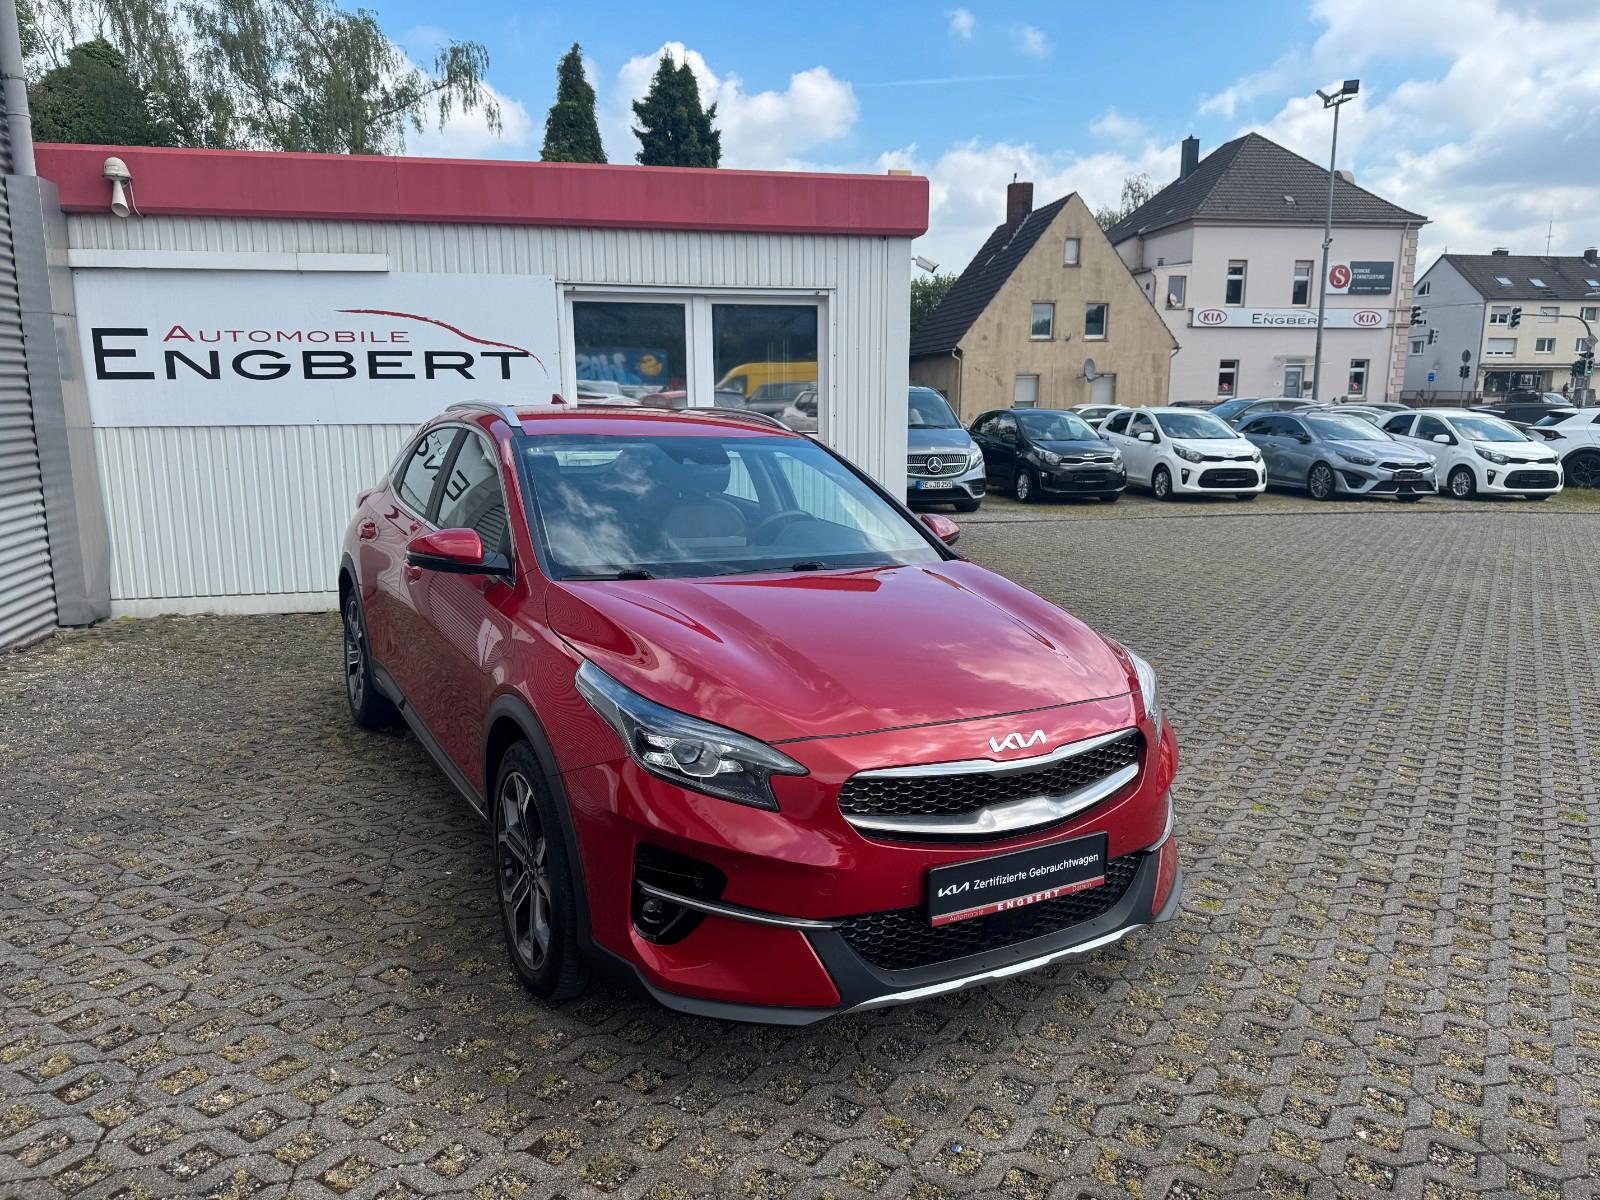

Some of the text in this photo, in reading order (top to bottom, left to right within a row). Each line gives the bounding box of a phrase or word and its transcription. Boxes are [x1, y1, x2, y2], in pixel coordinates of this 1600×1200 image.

[1203, 312, 1222, 322] KIA
[1252, 313, 1328, 325] ENGBER
[1358, 314, 1377, 323] KIA
[163, 325, 410, 343] AUTOMOBILE
[91, 327, 530, 381] ENGBERT
[988, 729, 1048, 753] KIA
[938, 853, 1099, 898] KIA Zertifizierte Gebrauchtwagen
[997, 889, 1060, 911] ENGBERT
